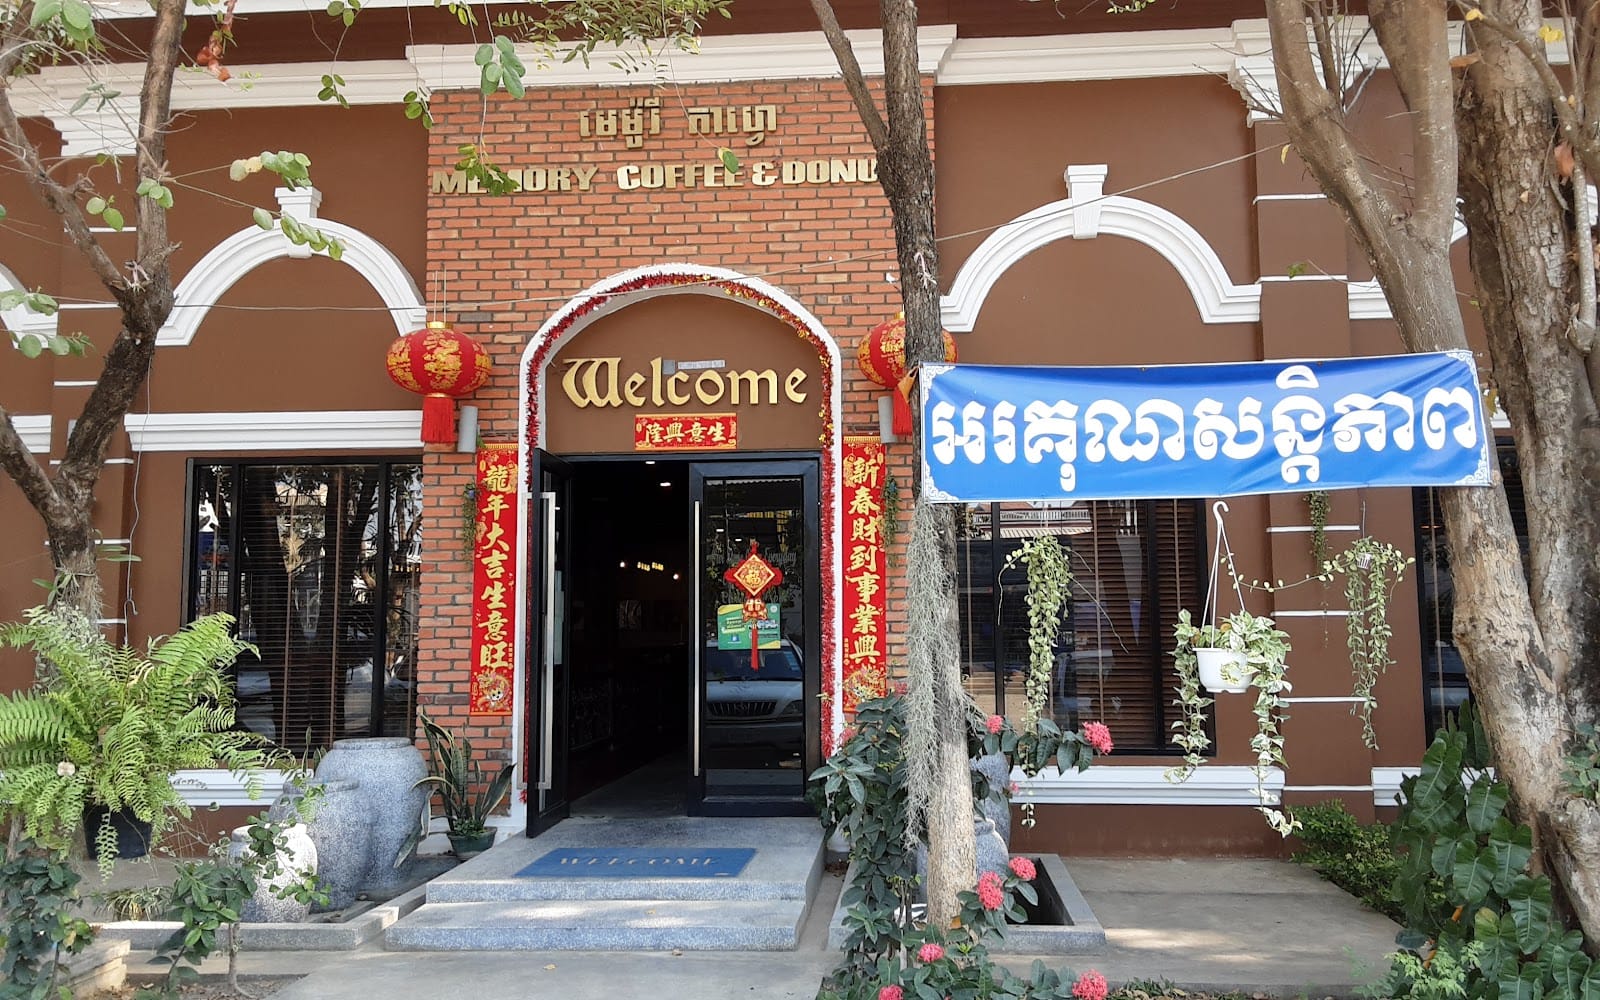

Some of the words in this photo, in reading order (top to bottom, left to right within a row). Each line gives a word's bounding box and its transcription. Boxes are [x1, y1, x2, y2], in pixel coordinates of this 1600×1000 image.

[616, 163, 745, 190] COFFEE
[752, 162, 778, 187] &
[782, 157, 879, 185] DONU
[561, 356, 808, 409] Welcome
[931, 364, 1478, 492] អរគុណសន្តិភាព
[478, 464, 511, 669] 龍年大吉生意旺
[845, 456, 881, 664] 新春財到事業興
